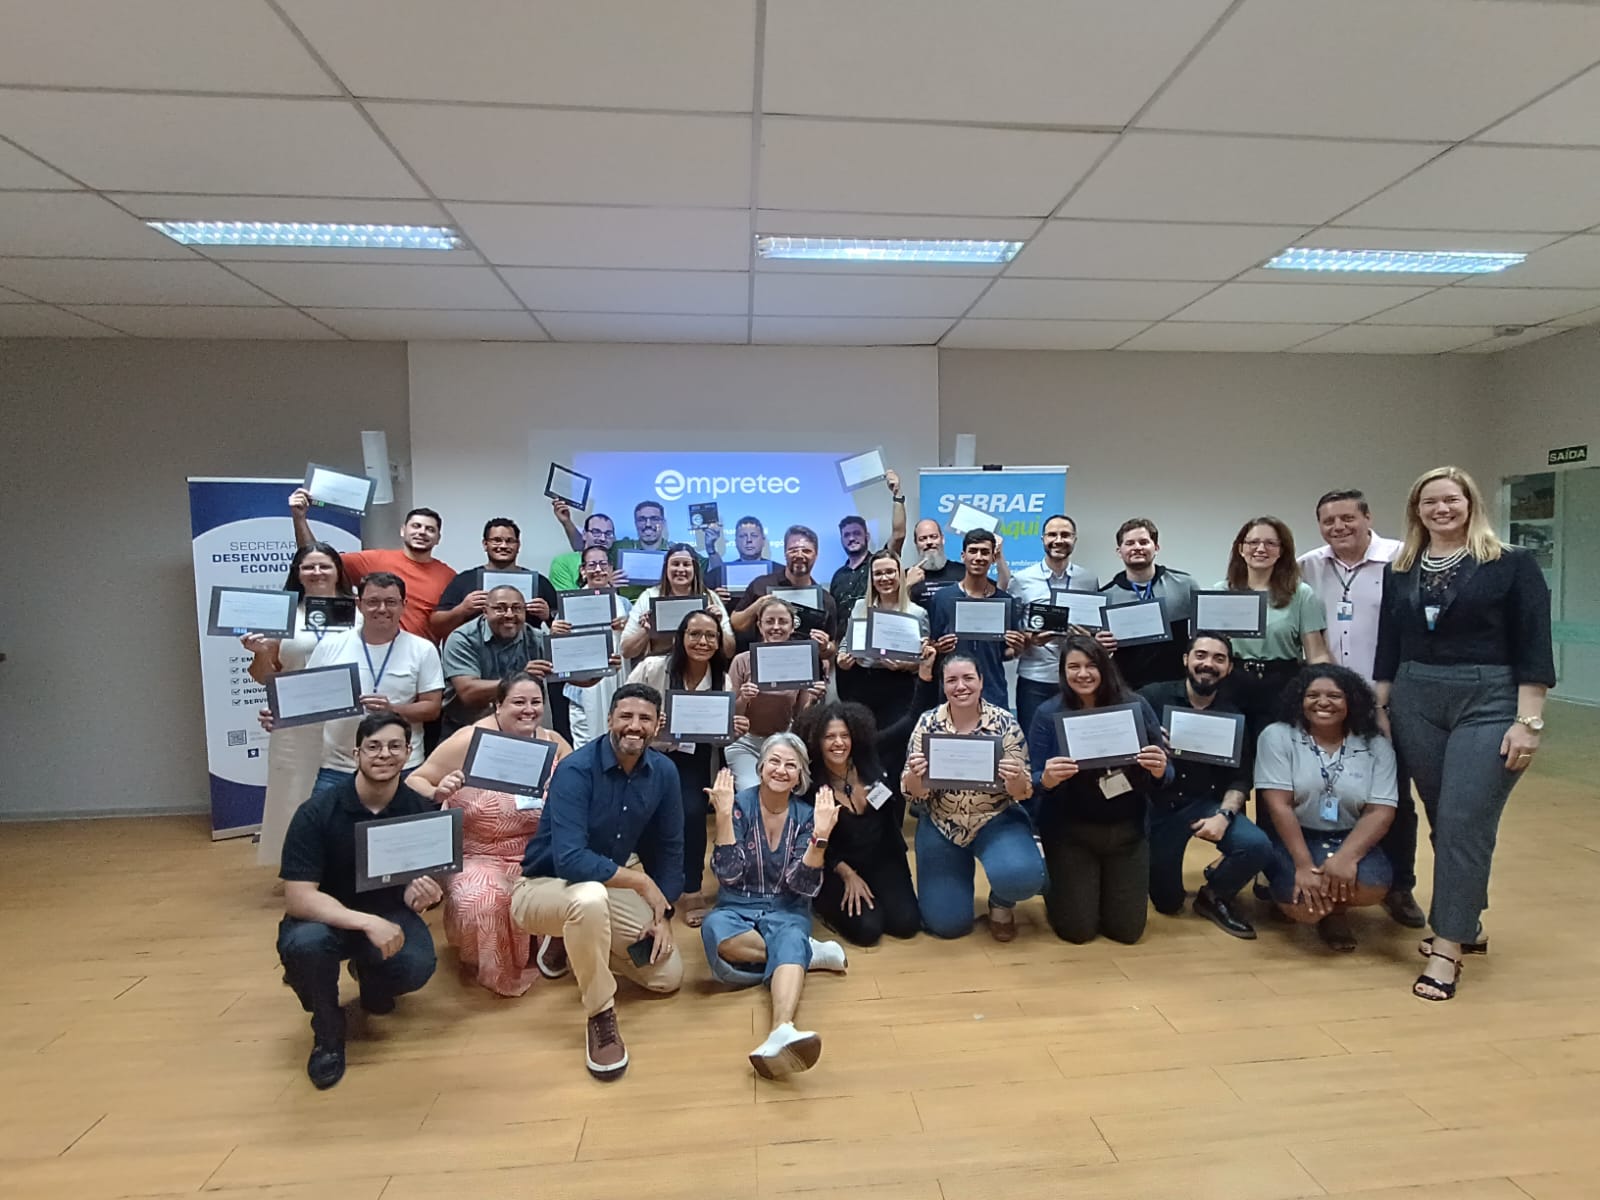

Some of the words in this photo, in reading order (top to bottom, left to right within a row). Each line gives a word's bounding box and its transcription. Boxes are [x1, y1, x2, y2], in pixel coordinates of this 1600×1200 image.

[1550, 449, 1585, 461] SAÍDA
[230, 541, 296, 551] SECRETAR
[212, 553, 294, 562] DESENVOLV
[240, 562, 288, 573] ECONÔ
